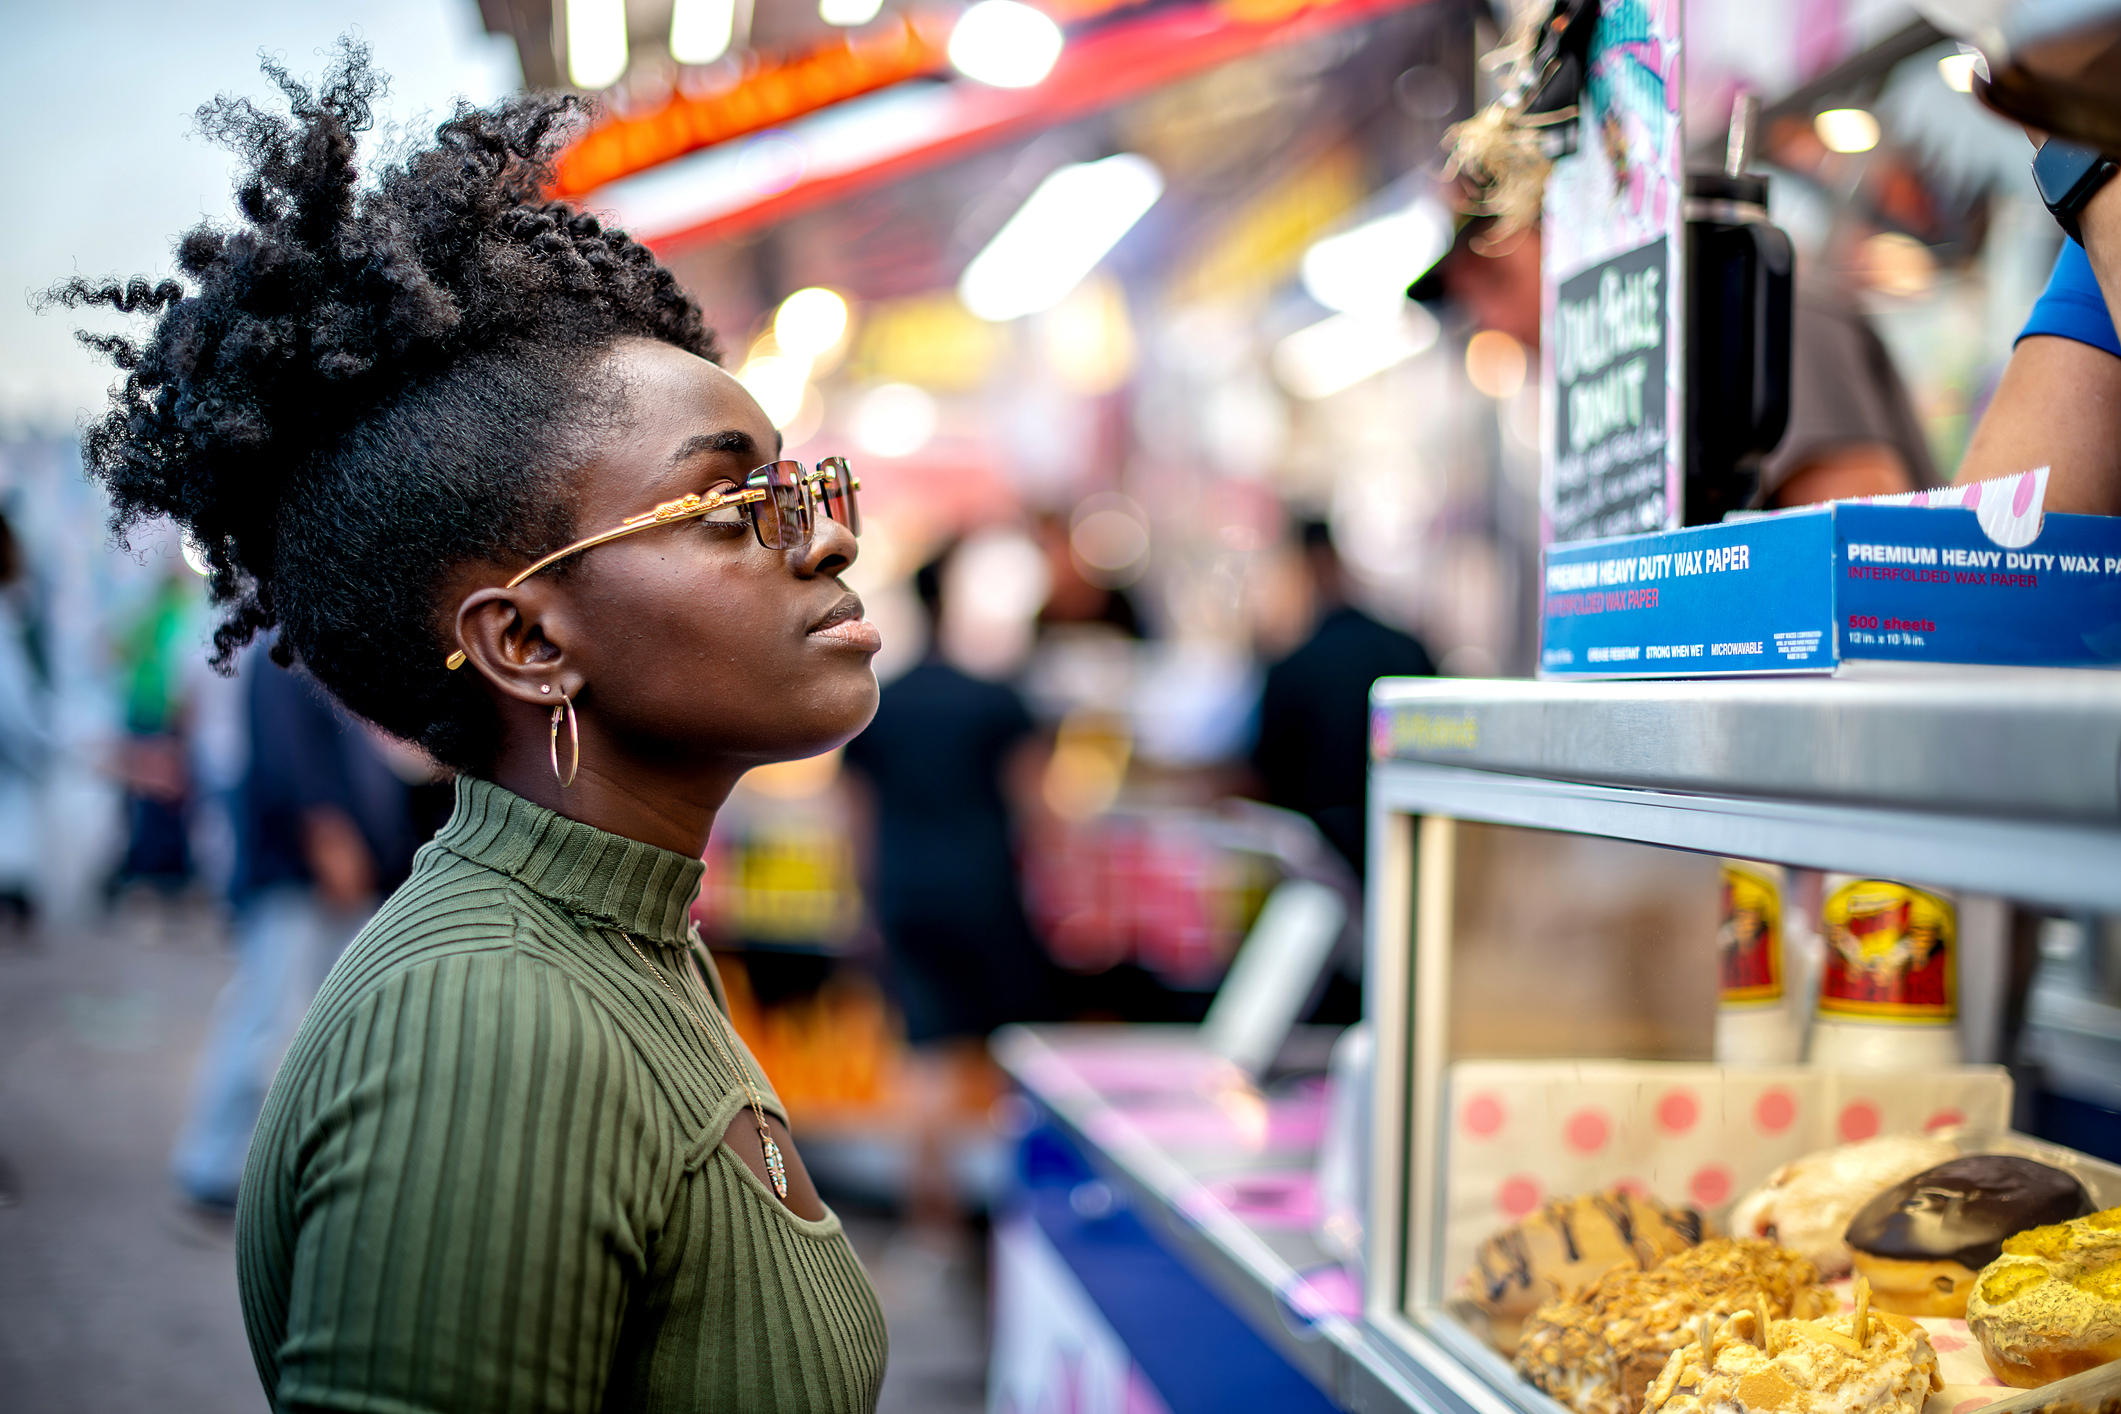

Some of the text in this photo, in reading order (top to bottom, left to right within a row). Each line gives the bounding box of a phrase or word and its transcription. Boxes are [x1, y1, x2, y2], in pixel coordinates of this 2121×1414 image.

[1568, 355, 1649, 454] DONUT
[1600, 556, 1638, 586] HEAVY
[1639, 553, 1673, 581] DUTY
[1674, 550, 1704, 577] WAX
[1705, 545, 1750, 573] PAPER
[1847, 543, 1938, 565] PREMIUM
[1941, 548, 2002, 569] HEAVY
[2006, 552, 2055, 571] DUTY
[2059, 554, 2100, 573] WAX
[1848, 565, 2038, 588] INTERFOLDED WAX PAPER
[1605, 590, 1627, 613] WAX
[1627, 588, 1659, 610] PAPER
[1848, 614, 1937, 632] 500 sheets
[1711, 641, 1763, 656] MICROWAVABLE
[1878, 635, 1885, 645] x
[1645, 644, 1704, 660] STRONG WHEN WET
